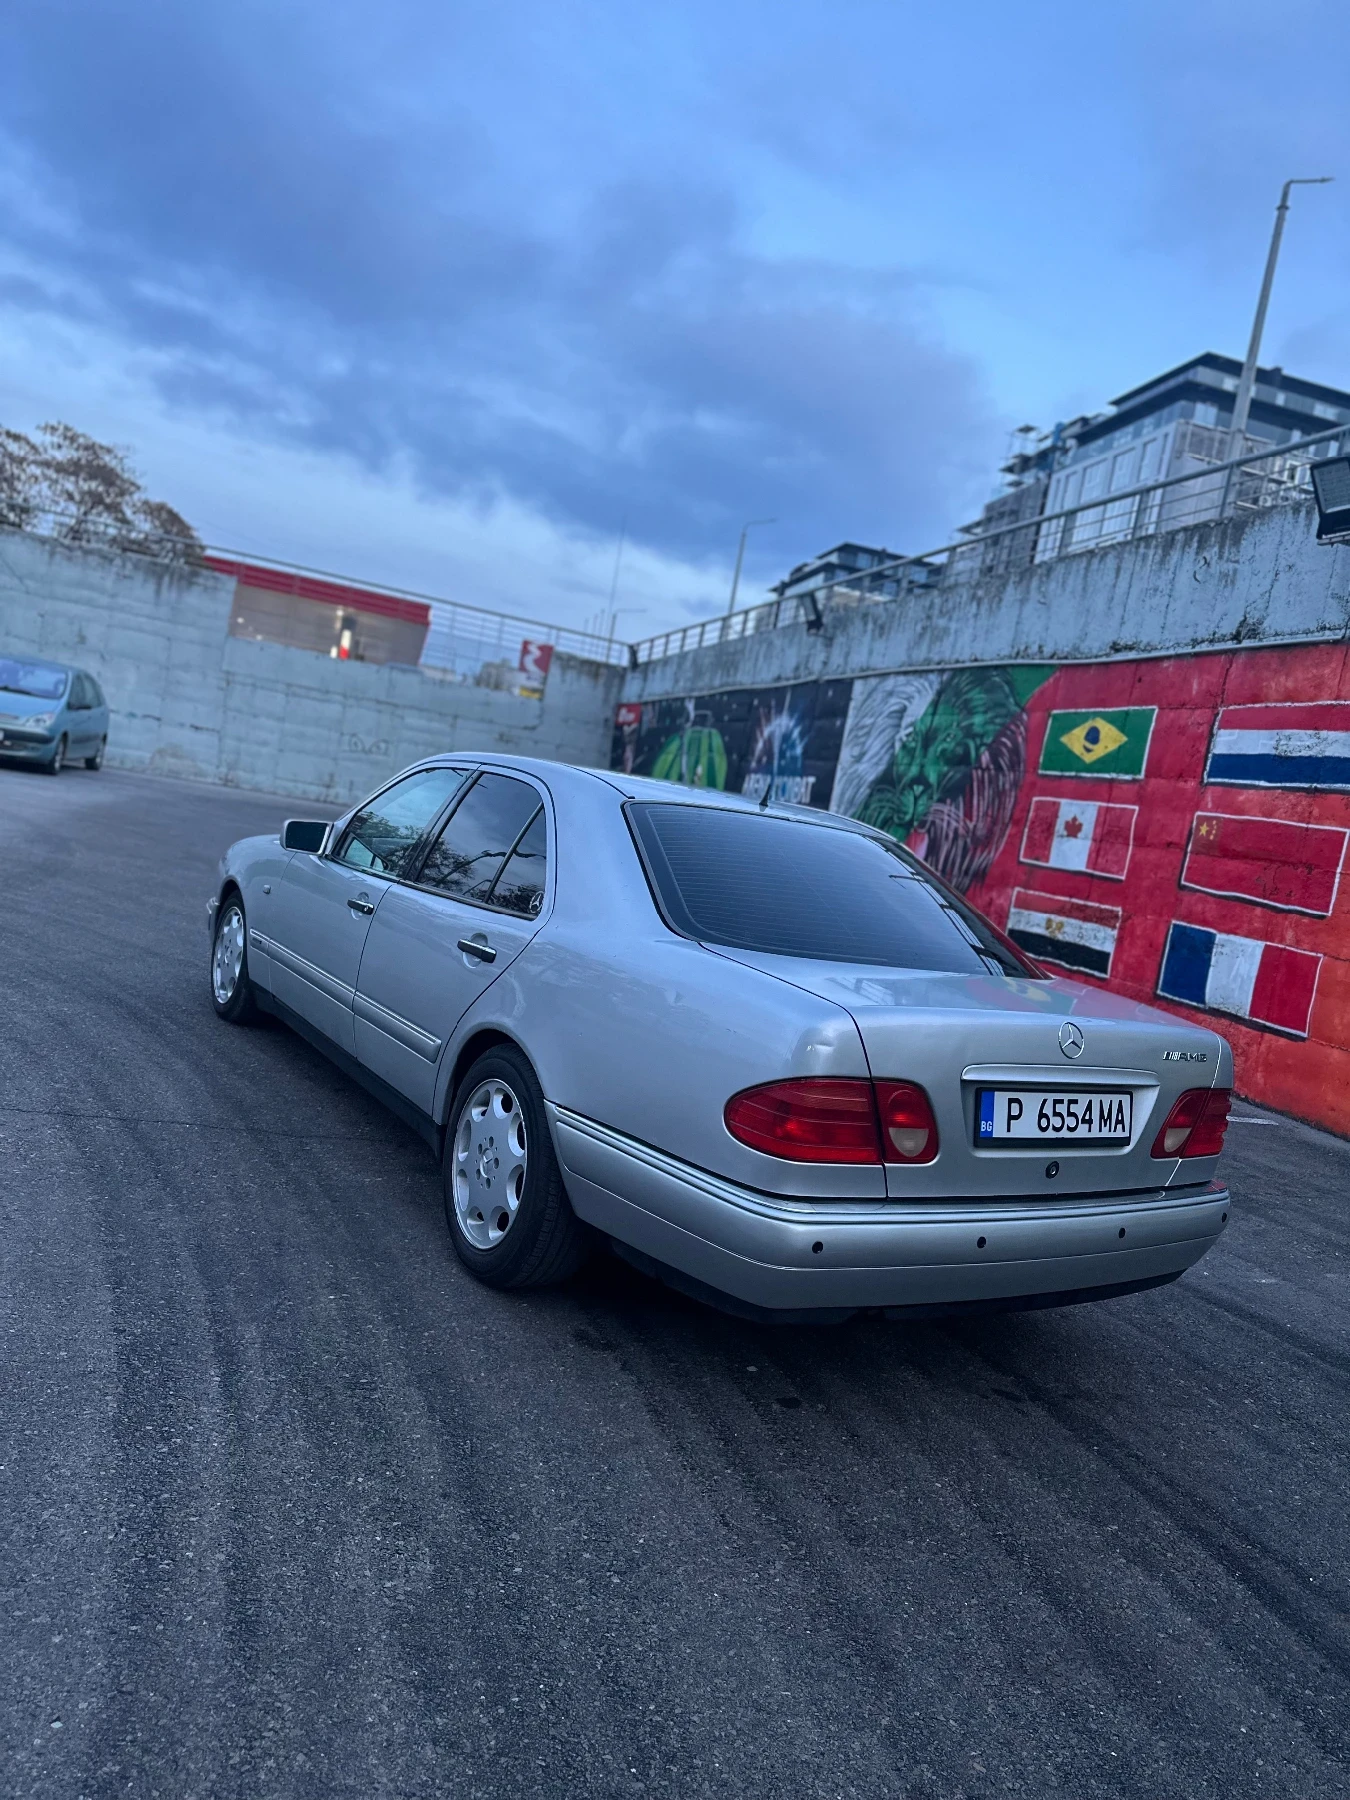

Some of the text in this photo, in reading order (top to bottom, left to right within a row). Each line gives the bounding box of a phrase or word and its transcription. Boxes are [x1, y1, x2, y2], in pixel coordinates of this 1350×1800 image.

[980, 1120, 993, 1132] BG
[1006, 1097, 1126, 1133] P 6554 MA
